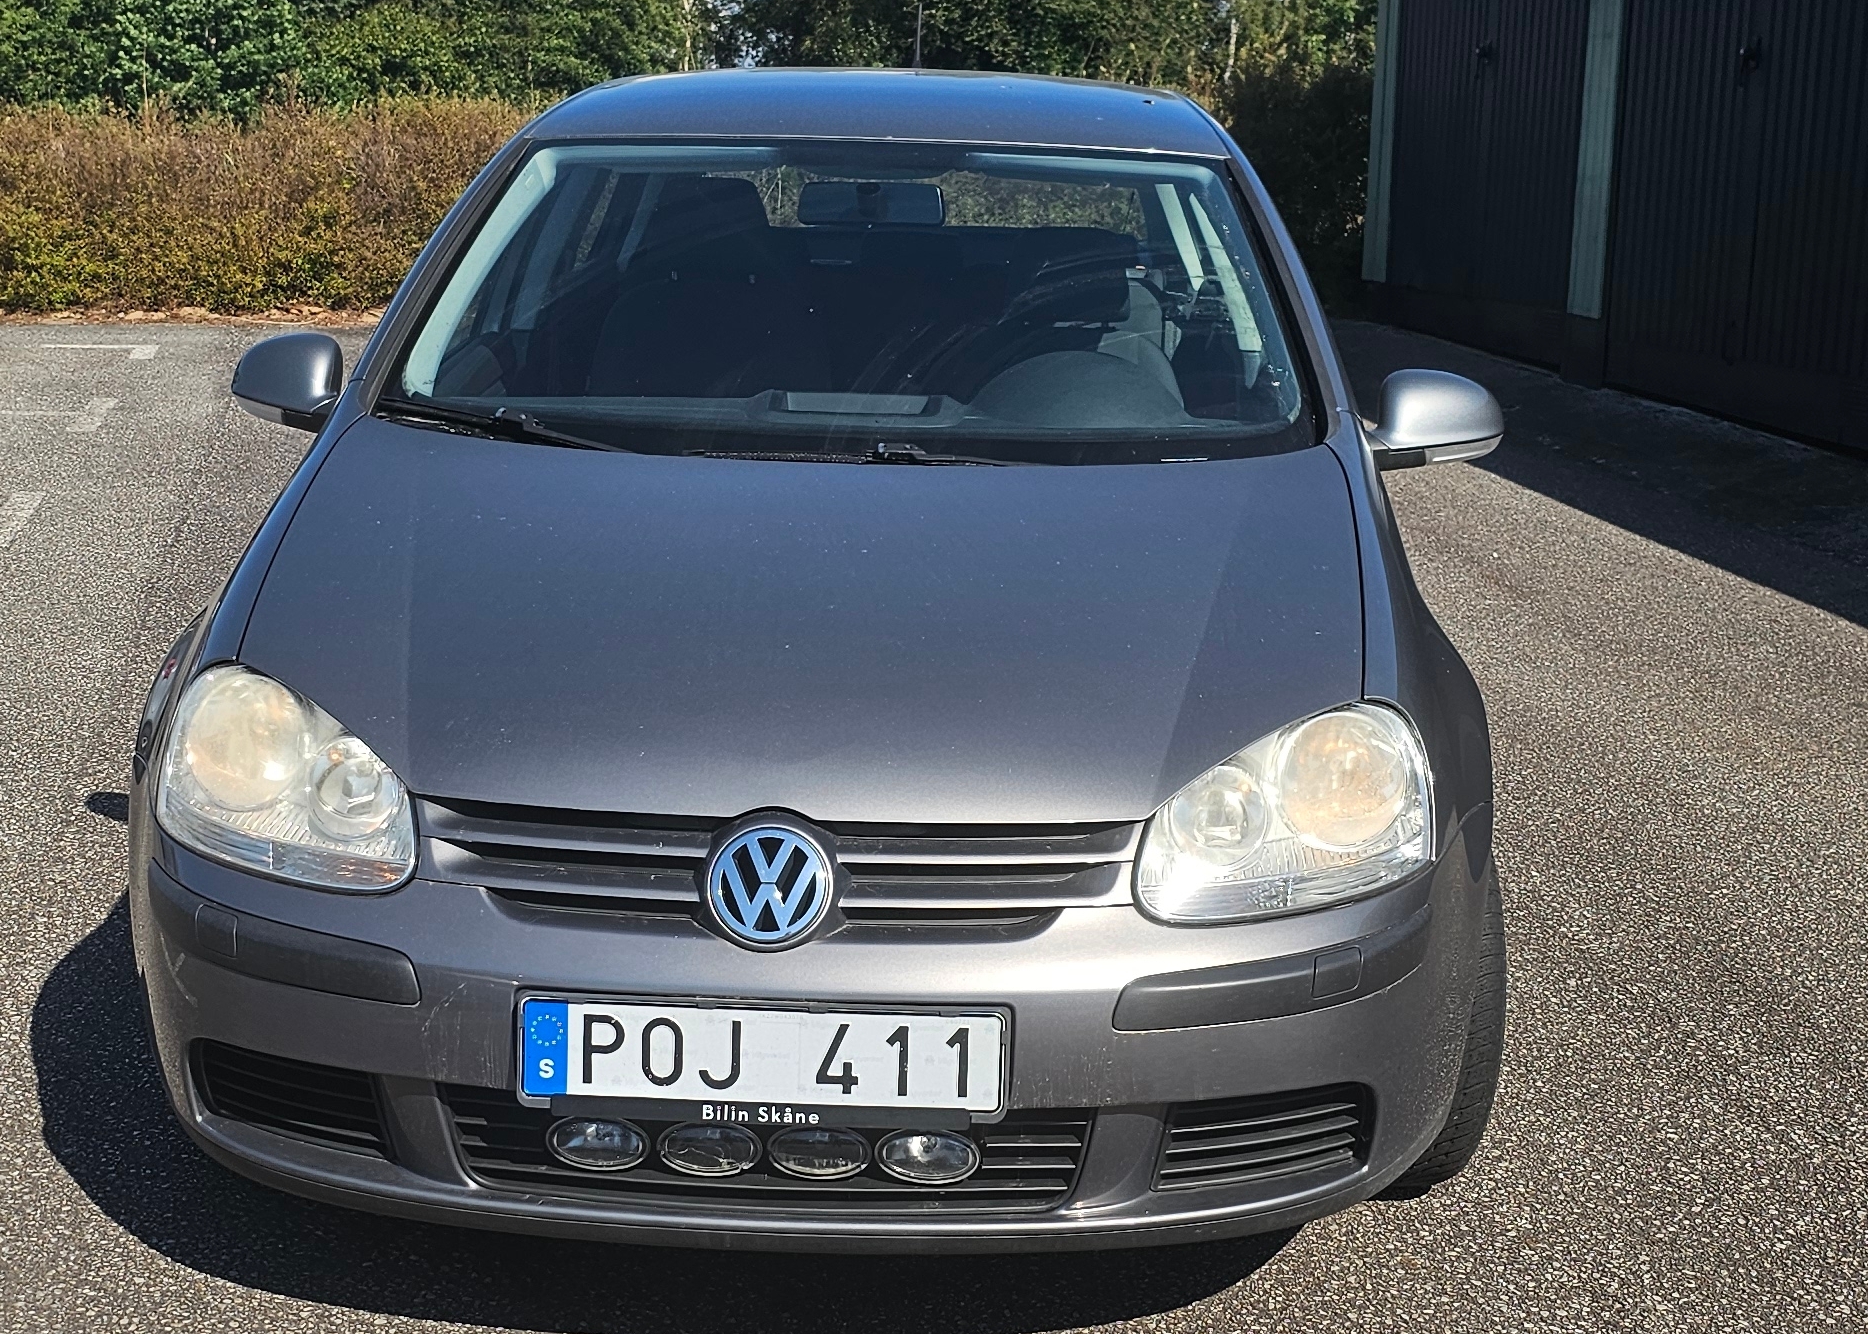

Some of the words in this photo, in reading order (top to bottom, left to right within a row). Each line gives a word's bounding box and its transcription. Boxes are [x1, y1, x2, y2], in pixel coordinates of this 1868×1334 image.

[712, 828, 828, 940] VW
[538, 1058, 555, 1079] S
[582, 1013, 742, 1090] POJ
[815, 1022, 970, 1098] 411
[702, 1104, 749, 1122] Bilin
[757, 1105, 820, 1125] Skåne
